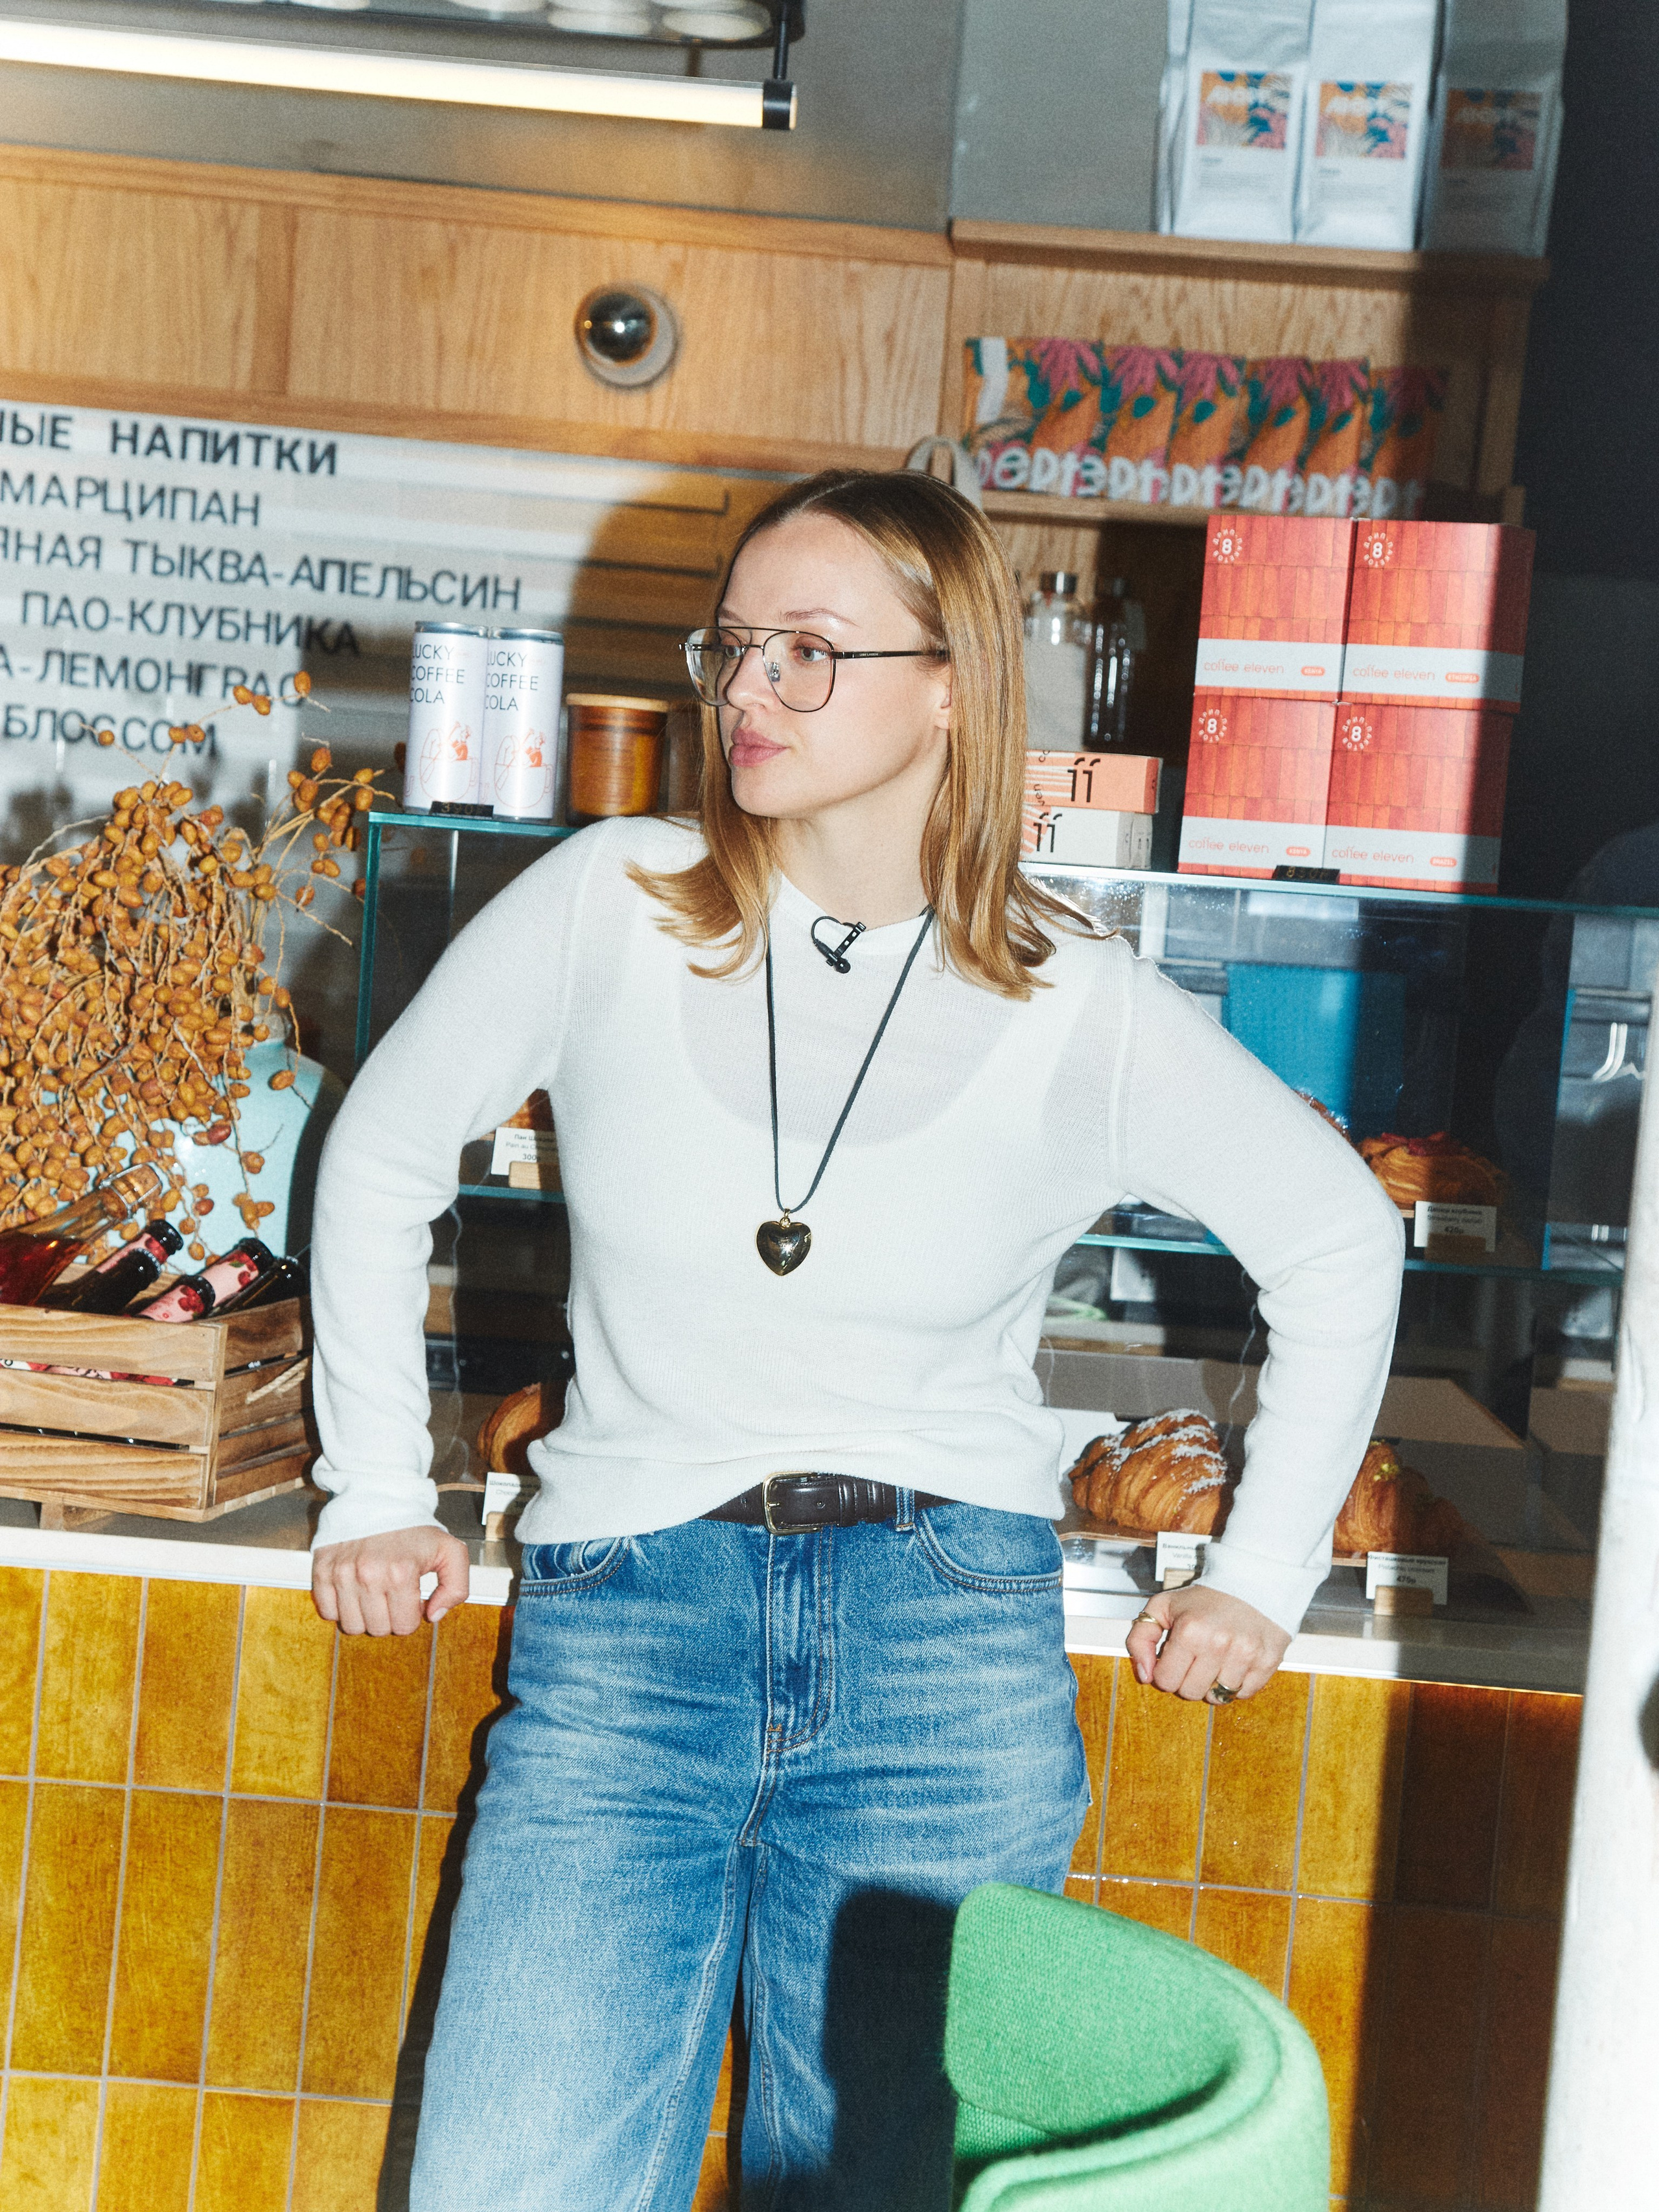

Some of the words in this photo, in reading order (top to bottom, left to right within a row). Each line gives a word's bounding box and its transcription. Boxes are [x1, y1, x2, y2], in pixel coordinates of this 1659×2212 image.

[0, 410, 73, 450] ЫЕ
[110, 420, 338, 476] НАПИТКИ
[0, 471, 261, 526] МАРЦИПАН
[1222, 538, 1232, 555] 8
[1373, 542, 1383, 559] 8
[124, 538, 522, 612] ТЫКВА-АПЕЛЬСИН
[22, 590, 360, 657] ПАО-КЛУБНИКА
[1203, 658, 1238, 672] coffee
[1244, 661, 1284, 675] eleven
[1352, 663, 1389, 678] coffee
[1394, 668, 1435, 681] eleven
[3, 704, 216, 757] БЛОССОМ
[1207, 718, 1217, 734] 8
[1351, 725, 1362, 742] 8
[1188, 837, 1224, 851] coffee
[1229, 841, 1270, 854] eleven
[1332, 845, 1368, 861] coffee
[1373, 850, 1414, 864] eleven
